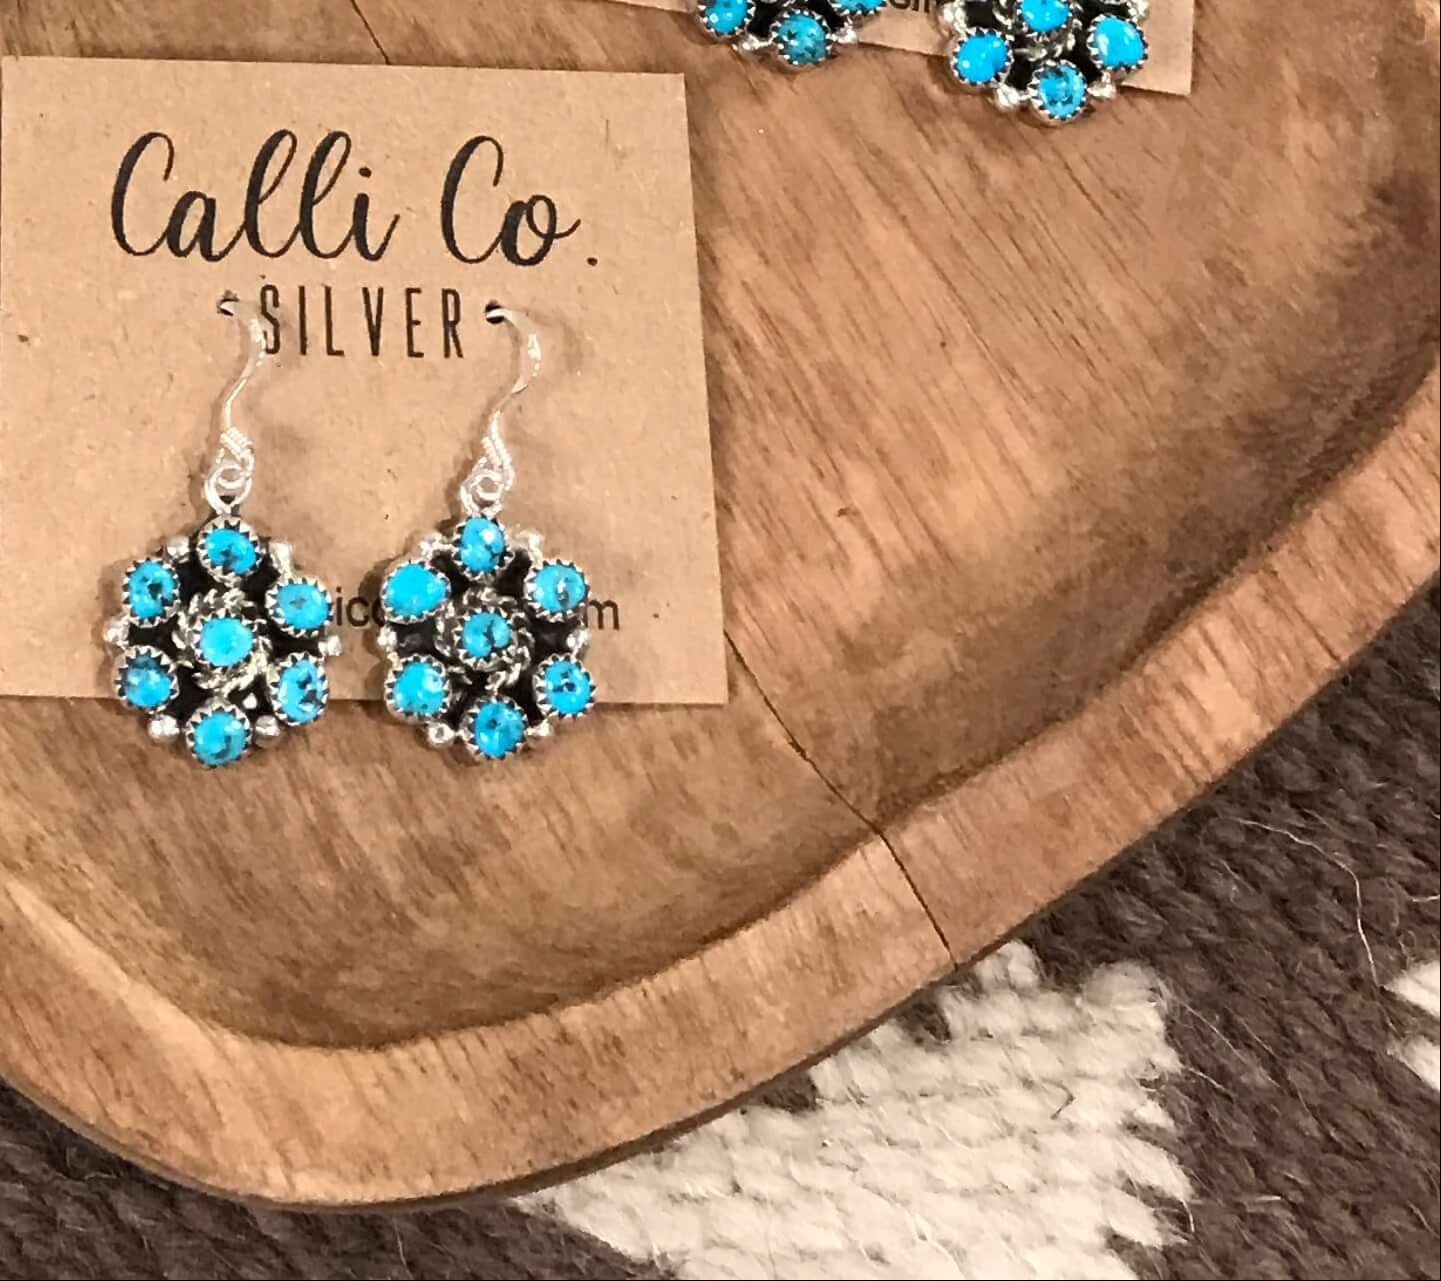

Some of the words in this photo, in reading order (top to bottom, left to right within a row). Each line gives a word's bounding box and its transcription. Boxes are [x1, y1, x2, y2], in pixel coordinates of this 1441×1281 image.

[111, 129, 400, 262] Calli
[441, 135, 598, 266] Co.
[260, 284, 464, 359] SILVER
